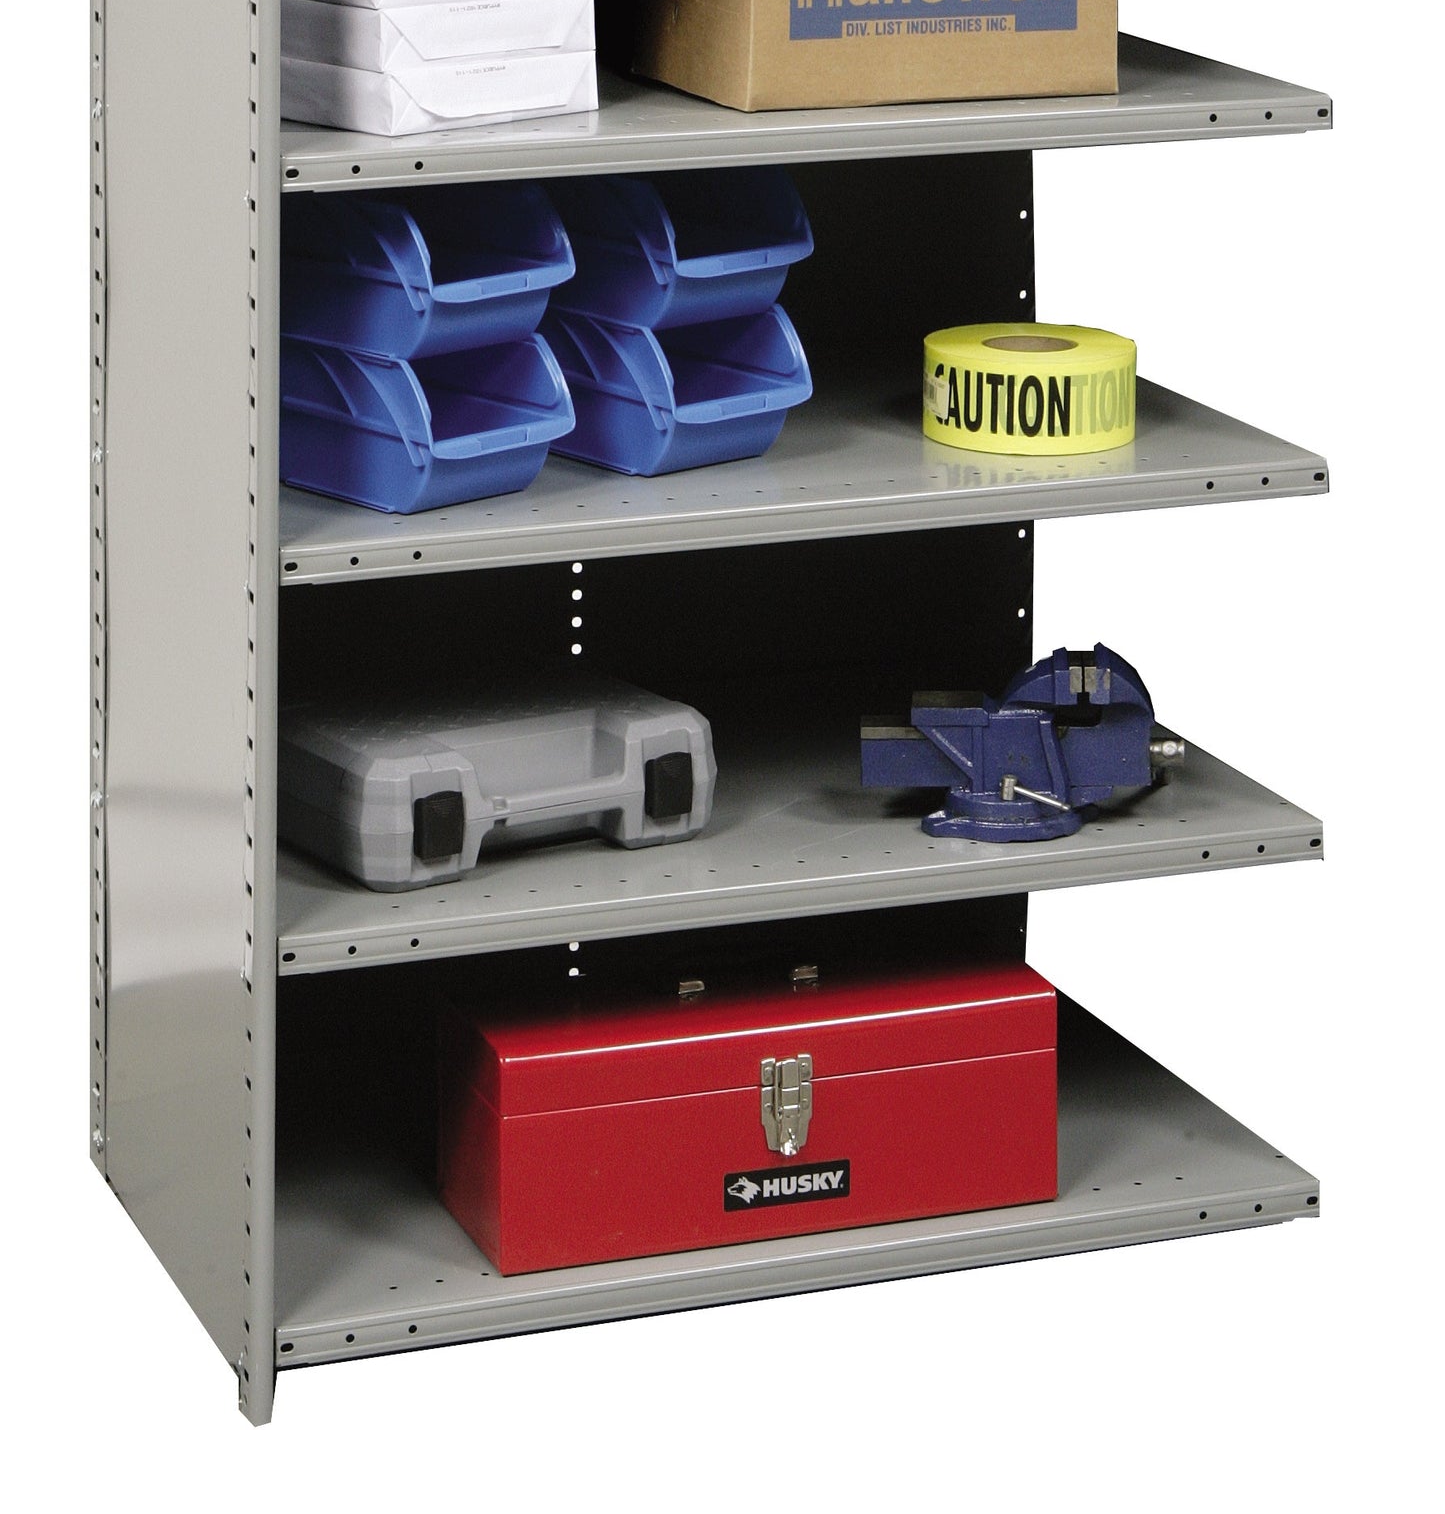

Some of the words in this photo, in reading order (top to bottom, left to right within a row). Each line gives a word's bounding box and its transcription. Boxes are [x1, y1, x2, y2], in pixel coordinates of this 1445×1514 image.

[846, 22, 870, 37] DIV.
[875, 21, 902, 36] LIST
[906, 18, 982, 34] INDUSTRIES
[986, 17, 1011, 31] INC.
[762, 1169, 844, 1198] HUSKY
